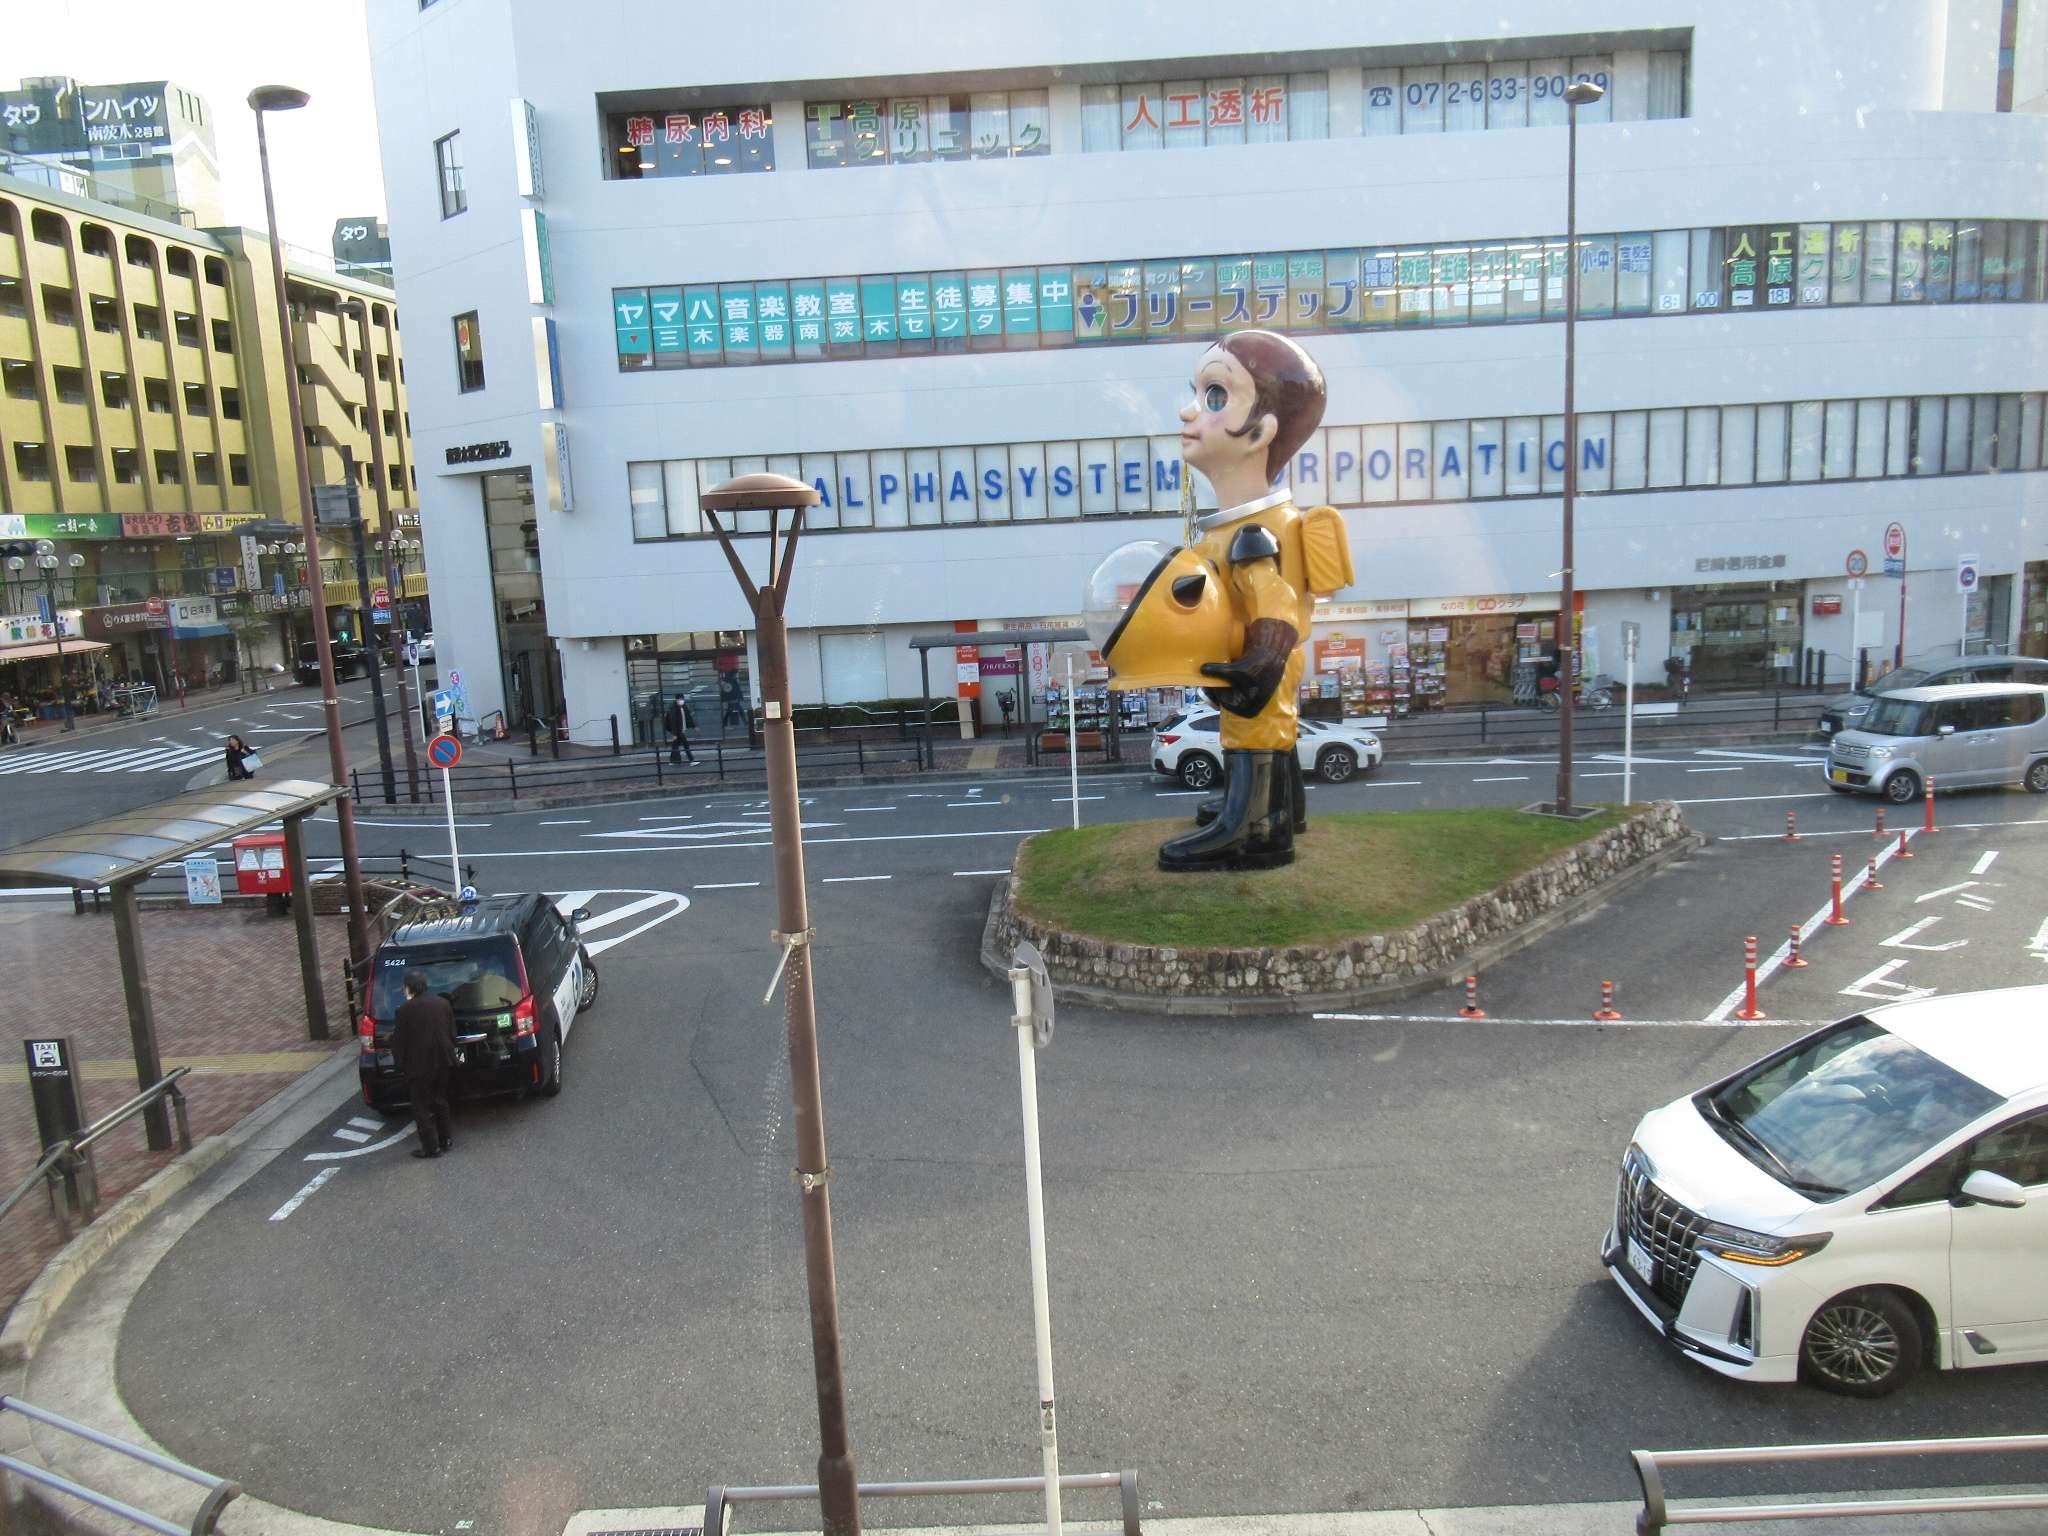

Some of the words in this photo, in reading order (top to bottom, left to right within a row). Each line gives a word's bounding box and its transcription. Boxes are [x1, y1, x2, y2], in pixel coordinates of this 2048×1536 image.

[626, 109, 768, 147] 糖尿内科
[851, 101, 923, 132] 高原
[1126, 87, 1284, 131] 人工透析
[854, 123, 1043, 161] クリニック
[617, 291, 858, 326] ヤマハ音楽教室
[900, 279, 1069, 310] 生徒募集中
[1112, 280, 1357, 329] フリーステップ
